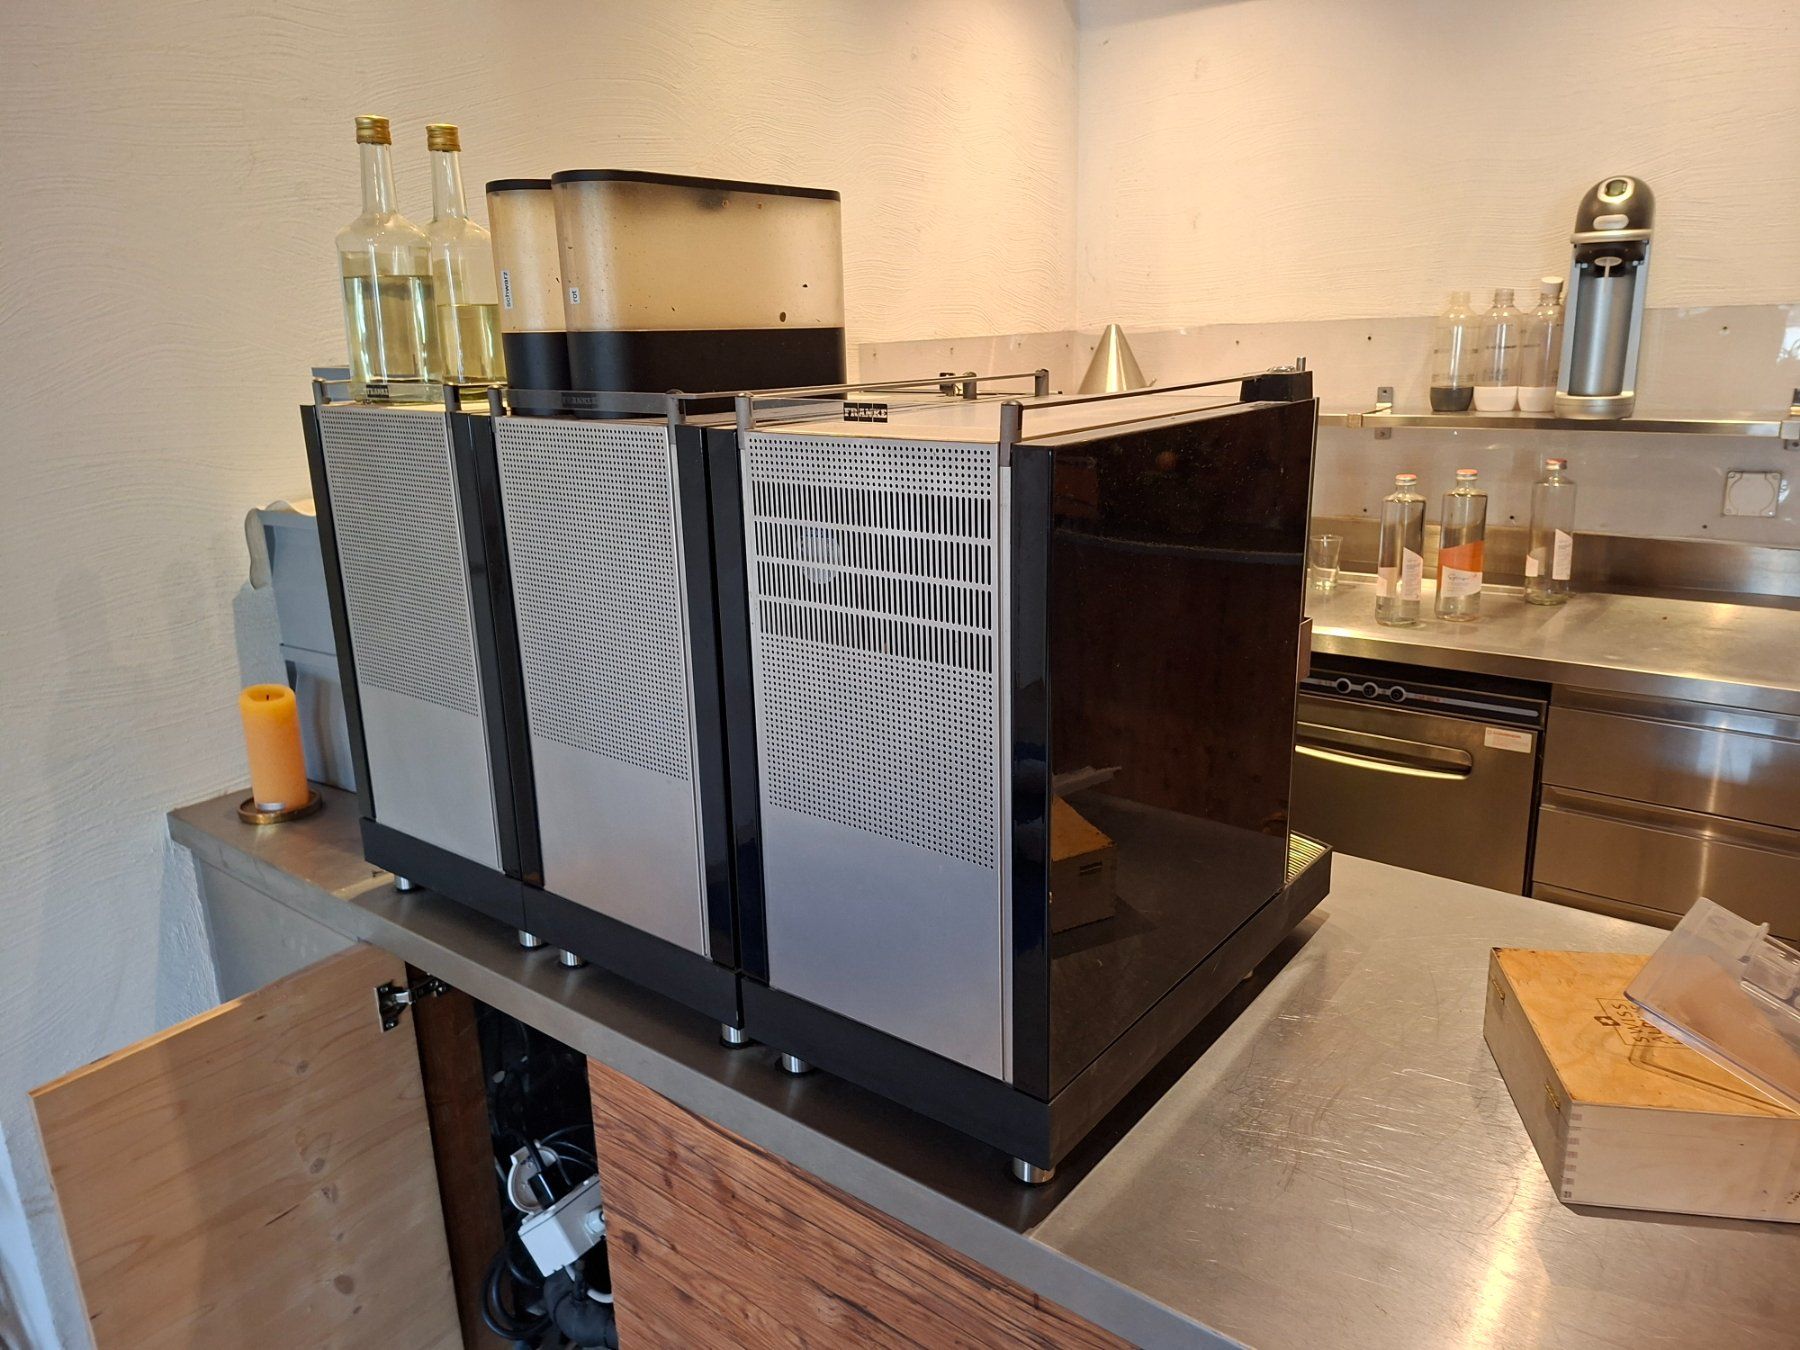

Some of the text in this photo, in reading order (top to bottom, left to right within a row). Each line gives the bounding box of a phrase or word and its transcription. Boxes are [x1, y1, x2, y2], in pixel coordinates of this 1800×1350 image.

[503, 272, 511, 307] schwarz
[844, 407, 887, 418] FRANKE
[1612, 1004, 1650, 1043] SWISS
